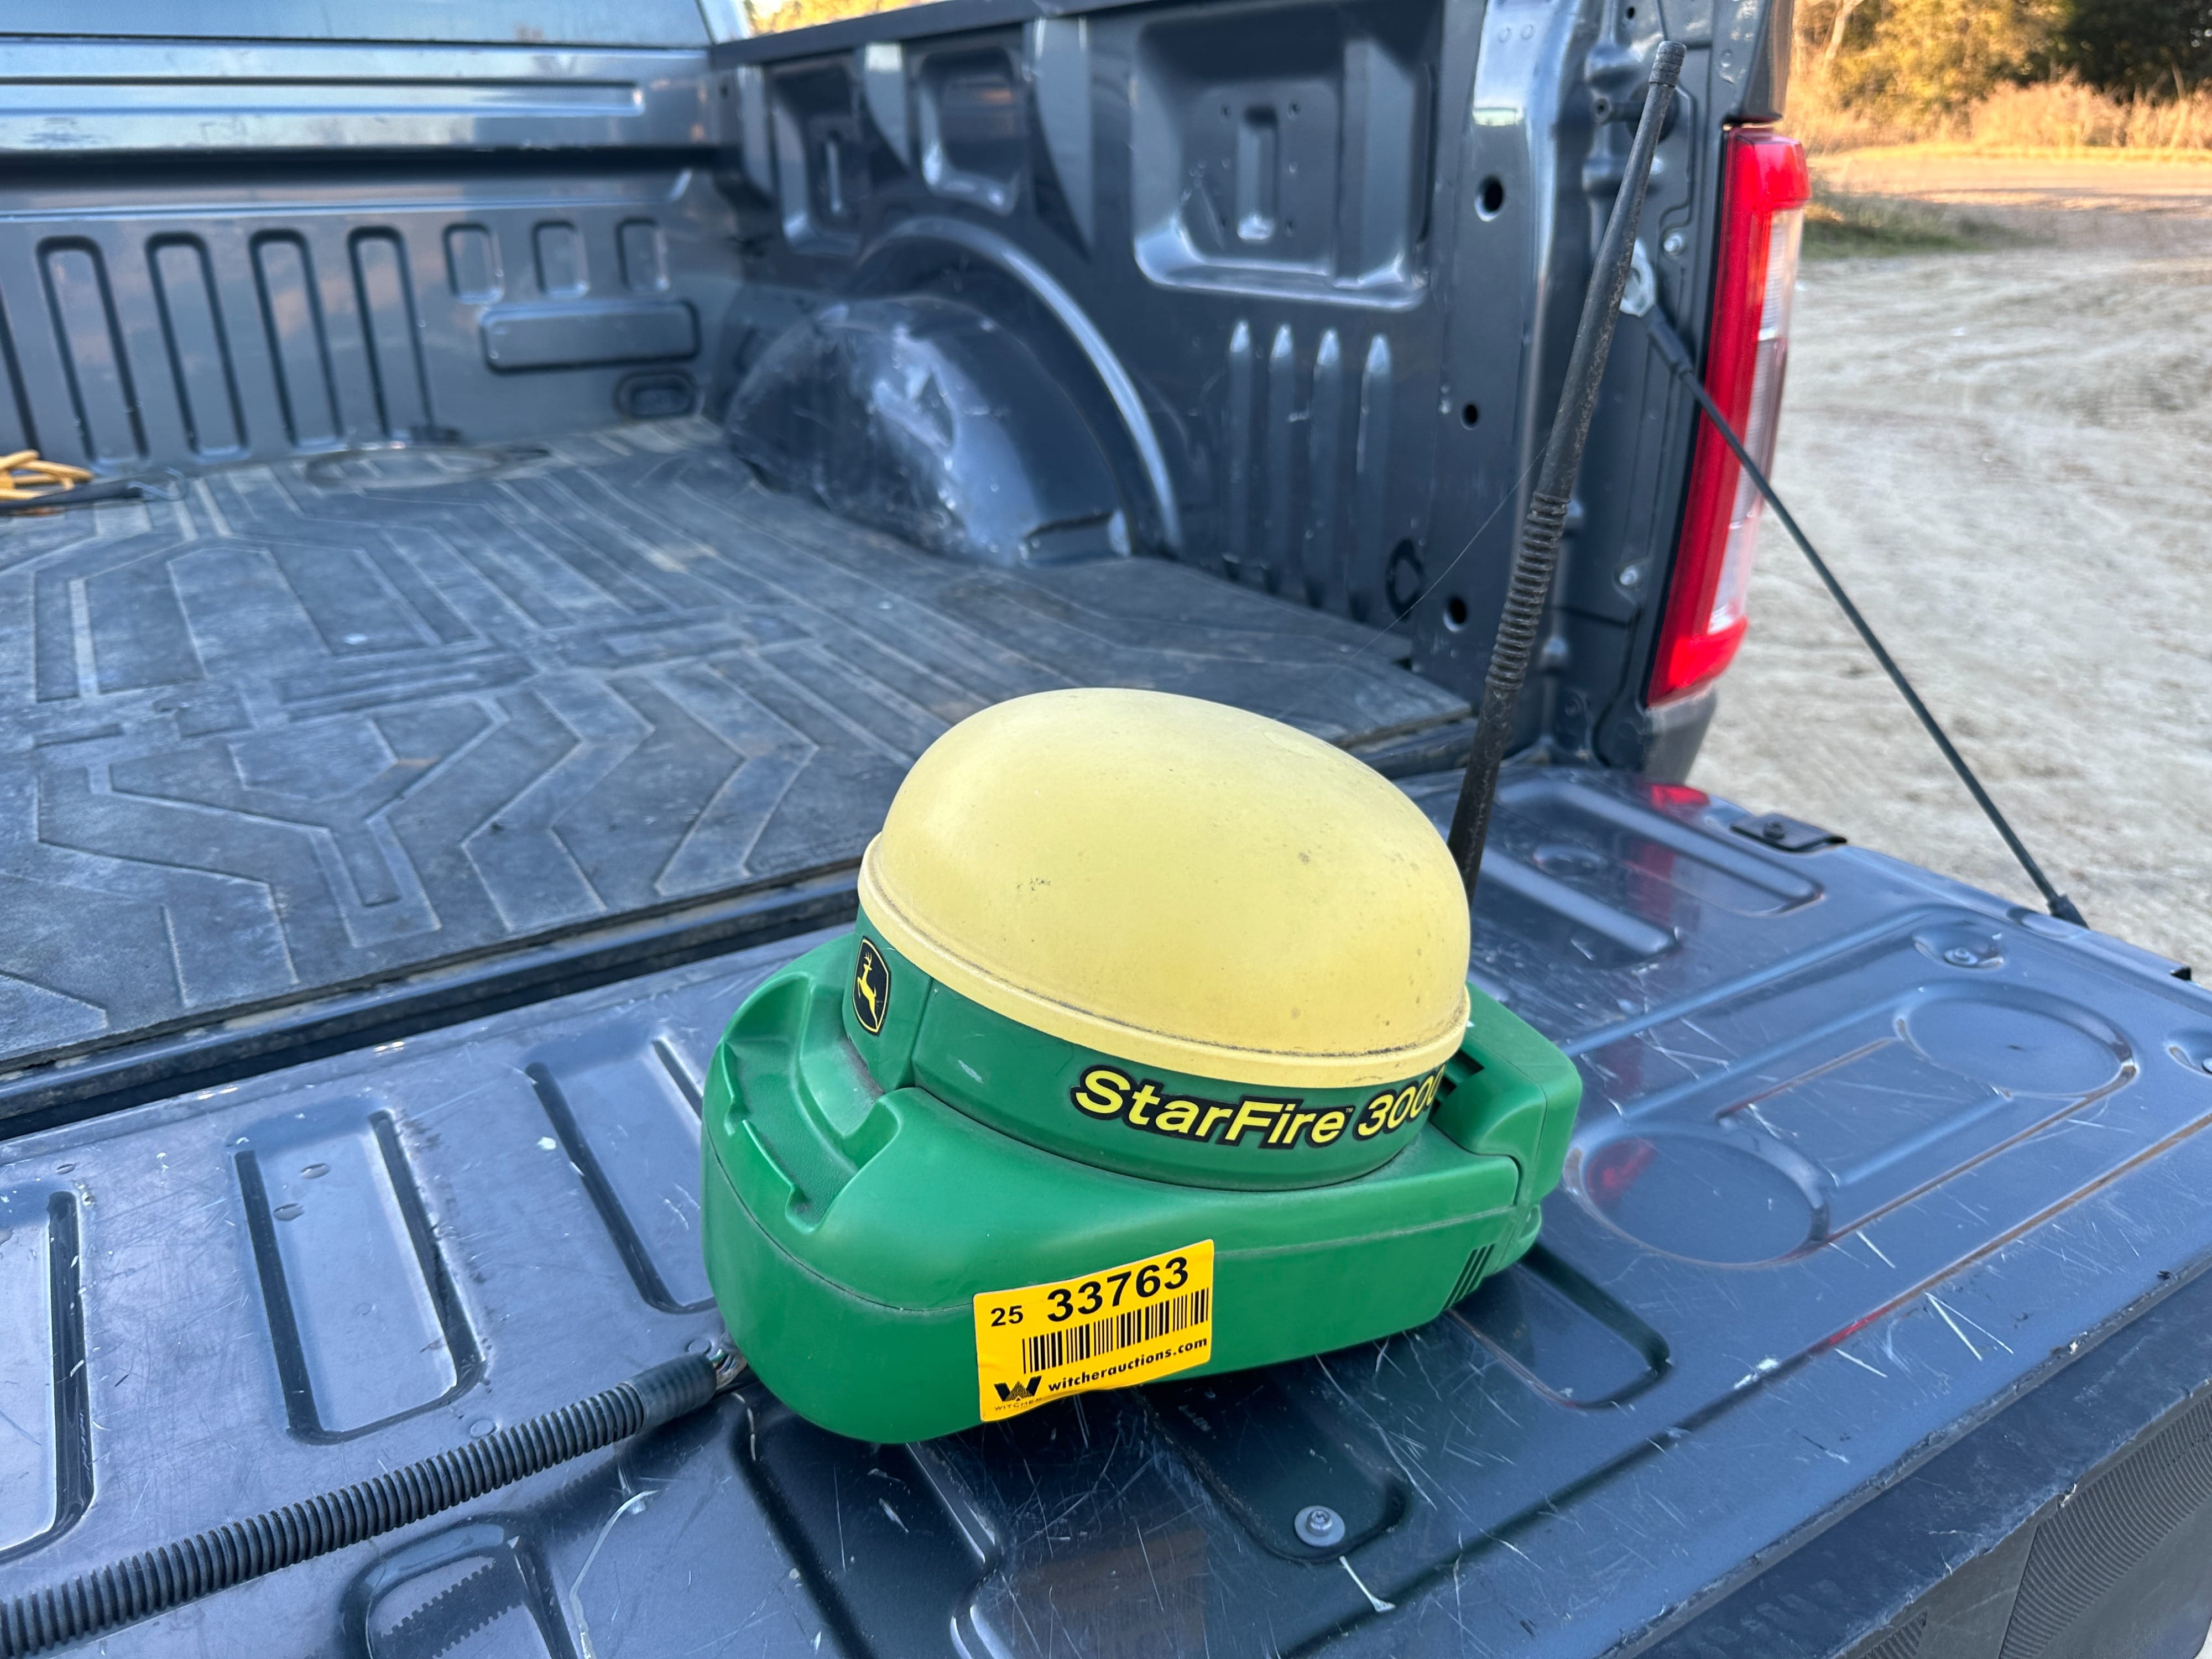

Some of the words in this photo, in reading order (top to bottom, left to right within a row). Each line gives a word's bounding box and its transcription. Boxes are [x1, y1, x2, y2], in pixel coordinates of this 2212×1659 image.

[1075, 1070, 1345, 1144] StarFire
[990, 1305, 1024, 1327] 25
[1047, 1256, 1188, 1322] 33763
[1048, 1337, 1208, 1392] witcherauctions.com
